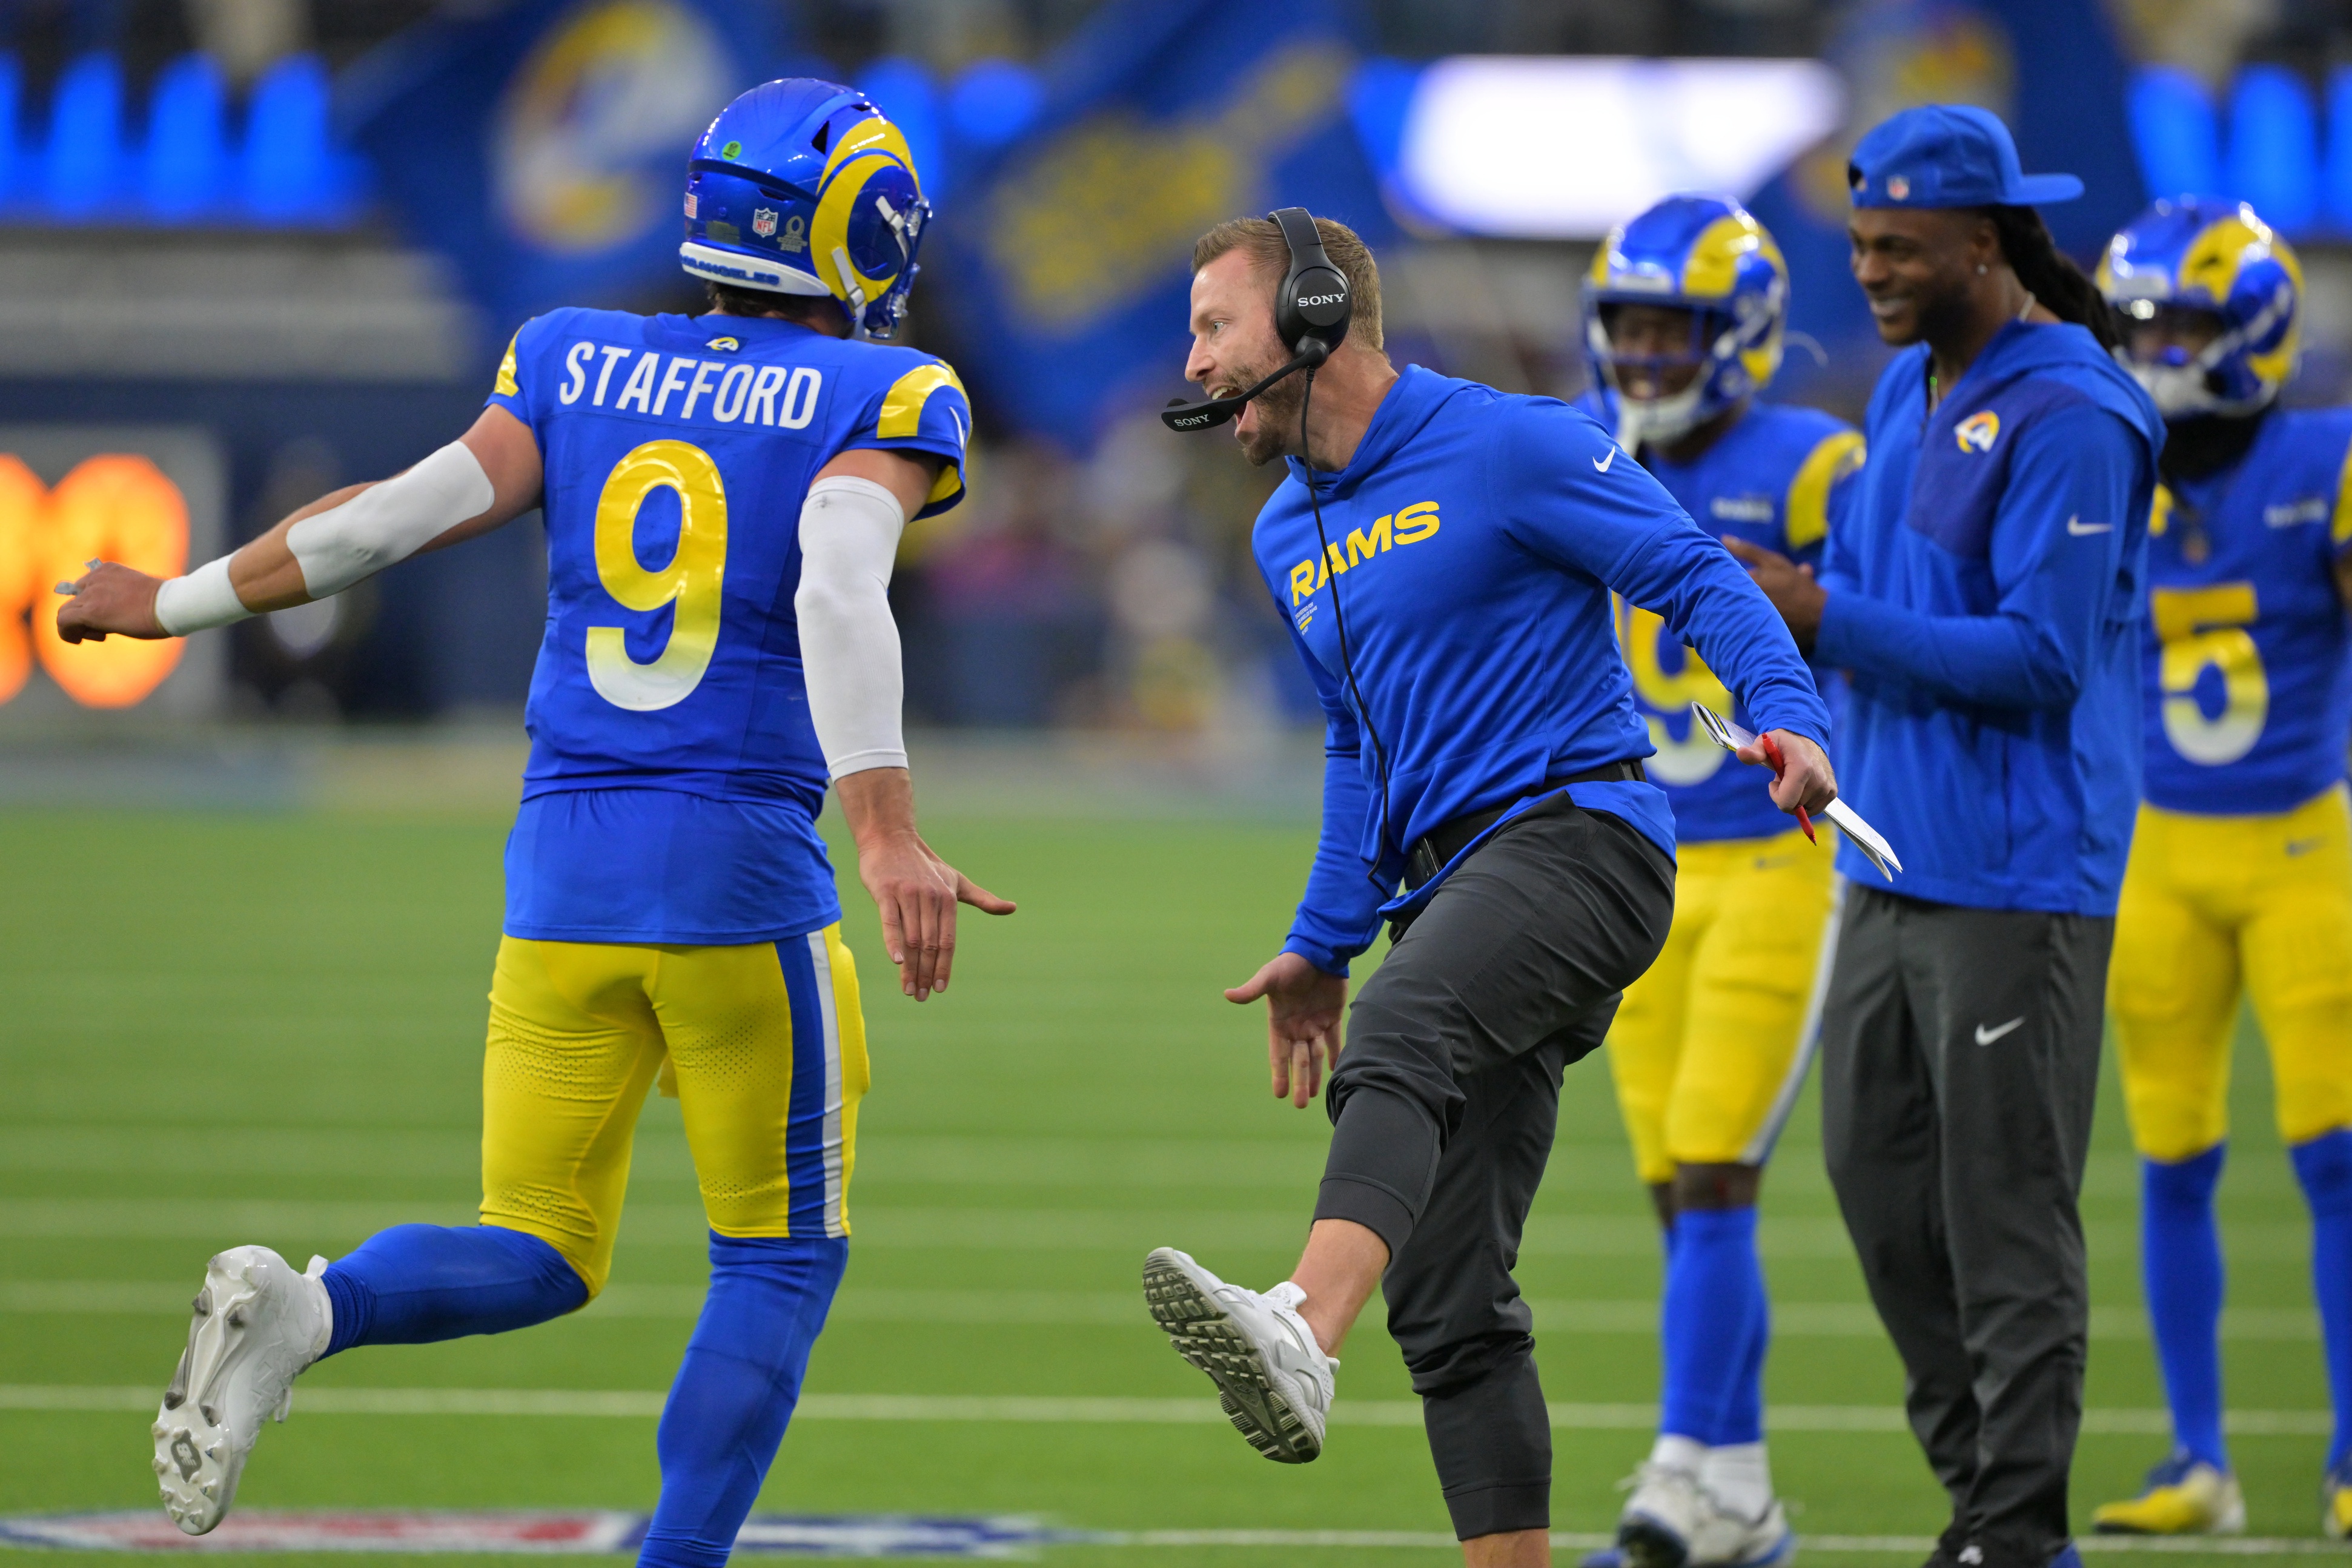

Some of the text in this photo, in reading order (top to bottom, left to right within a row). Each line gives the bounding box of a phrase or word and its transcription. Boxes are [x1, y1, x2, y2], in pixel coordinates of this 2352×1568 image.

[756, 220, 774, 233] NFL
[1297, 293, 1345, 307] SONY
[559, 340, 822, 430] STAFFORD
[1174, 414, 1210, 427] SONY
[585, 439, 727, 711] 9
[1290, 501, 1440, 607] RAMS
[2151, 581, 2270, 767] 5
